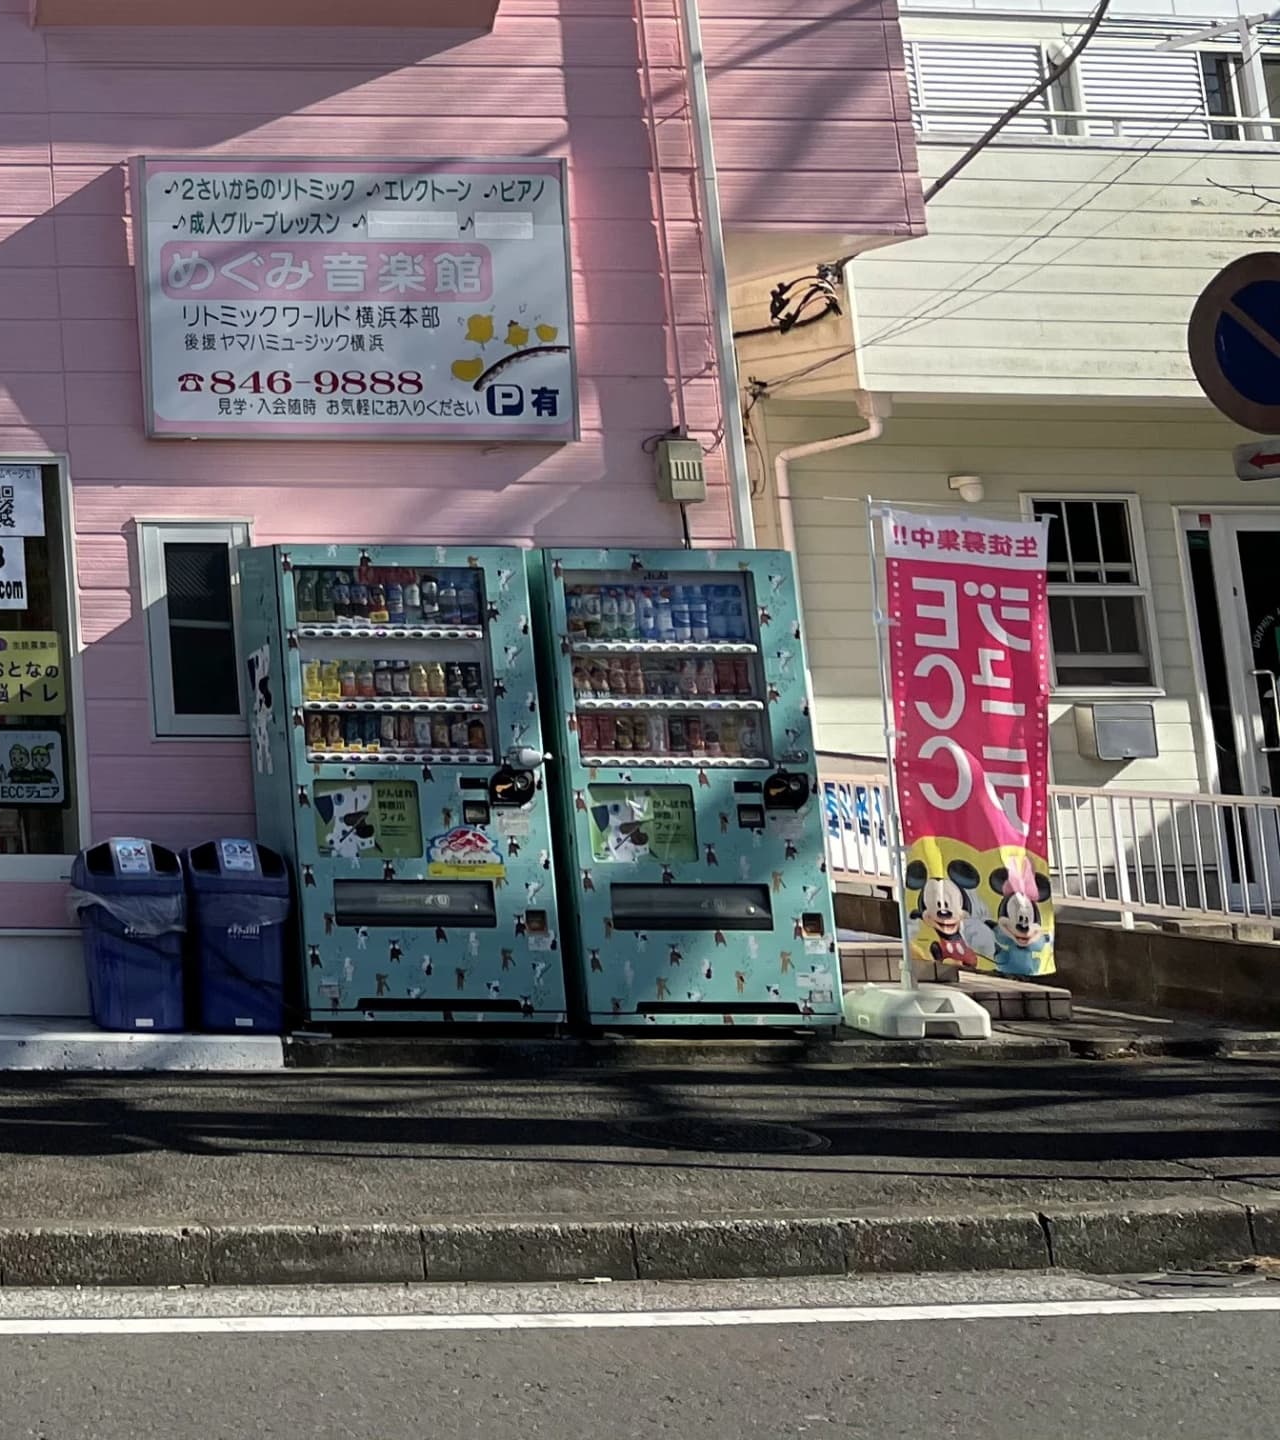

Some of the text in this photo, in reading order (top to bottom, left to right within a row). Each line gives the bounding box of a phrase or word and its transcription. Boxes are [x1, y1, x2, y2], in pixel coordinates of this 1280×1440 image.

[189, 212, 341, 236] 成人グループレッスン
[166, 248, 482, 294] めぐみ音楽館
[209, 369, 424, 395] 846-9888
[326, 398, 481, 417] お気軽にお入りください
[0, 785, 60, 799] ECCジュニア
